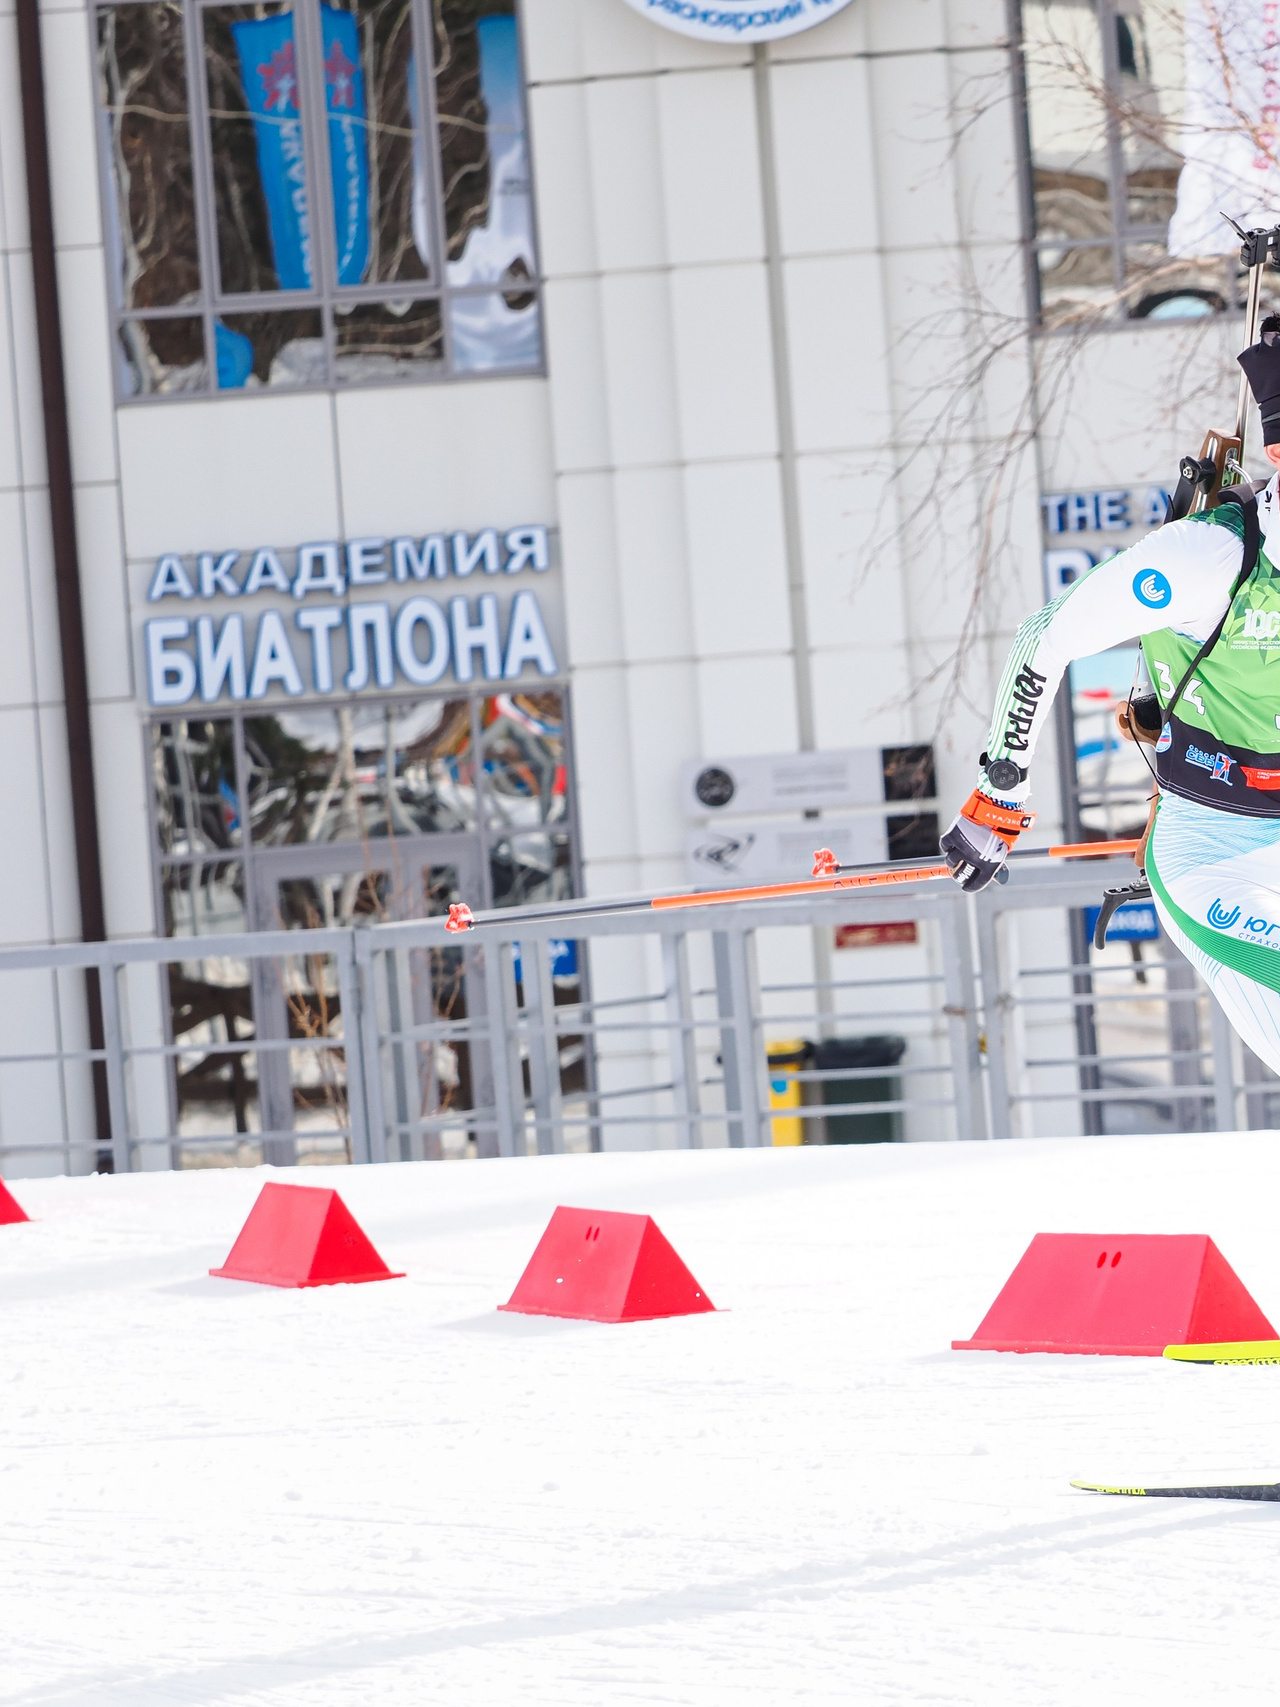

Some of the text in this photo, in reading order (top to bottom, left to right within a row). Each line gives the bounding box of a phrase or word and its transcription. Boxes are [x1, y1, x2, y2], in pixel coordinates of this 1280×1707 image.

[1042, 489, 1131, 533] THE
[148, 525, 551, 600] АКАДЕМИЯ
[145, 590, 558, 706] БИАТЛОНА
[1153, 660, 1206, 716] 34
